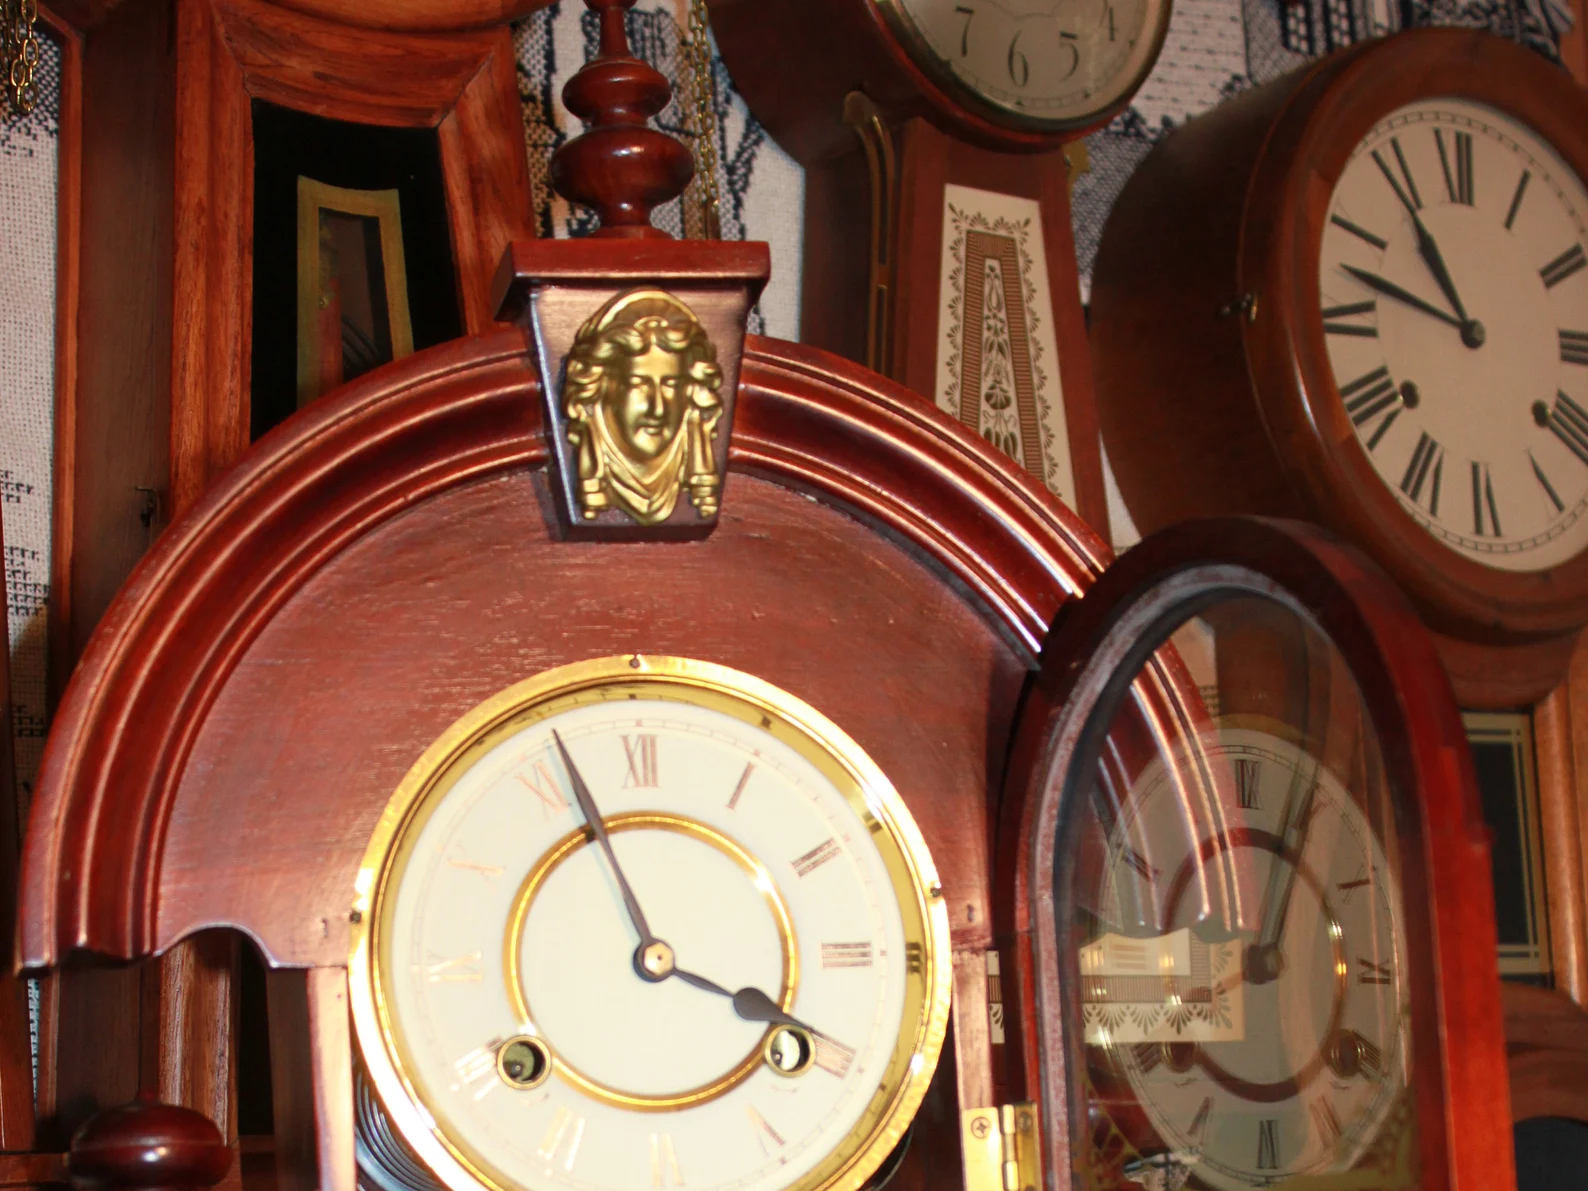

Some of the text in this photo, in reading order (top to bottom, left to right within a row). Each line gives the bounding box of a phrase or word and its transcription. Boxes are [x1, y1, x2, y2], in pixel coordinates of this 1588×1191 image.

[955, 6, 975, 57] 7
[1101, 6, 1119, 42] 4
[1008, 29, 1029, 88] 6
[1059, 31, 1080, 83] 5
[1433, 127, 1474, 207] XII
[621, 734, 658, 788] XII
[726, 761, 756, 810] I
[790, 837, 842, 877] II
